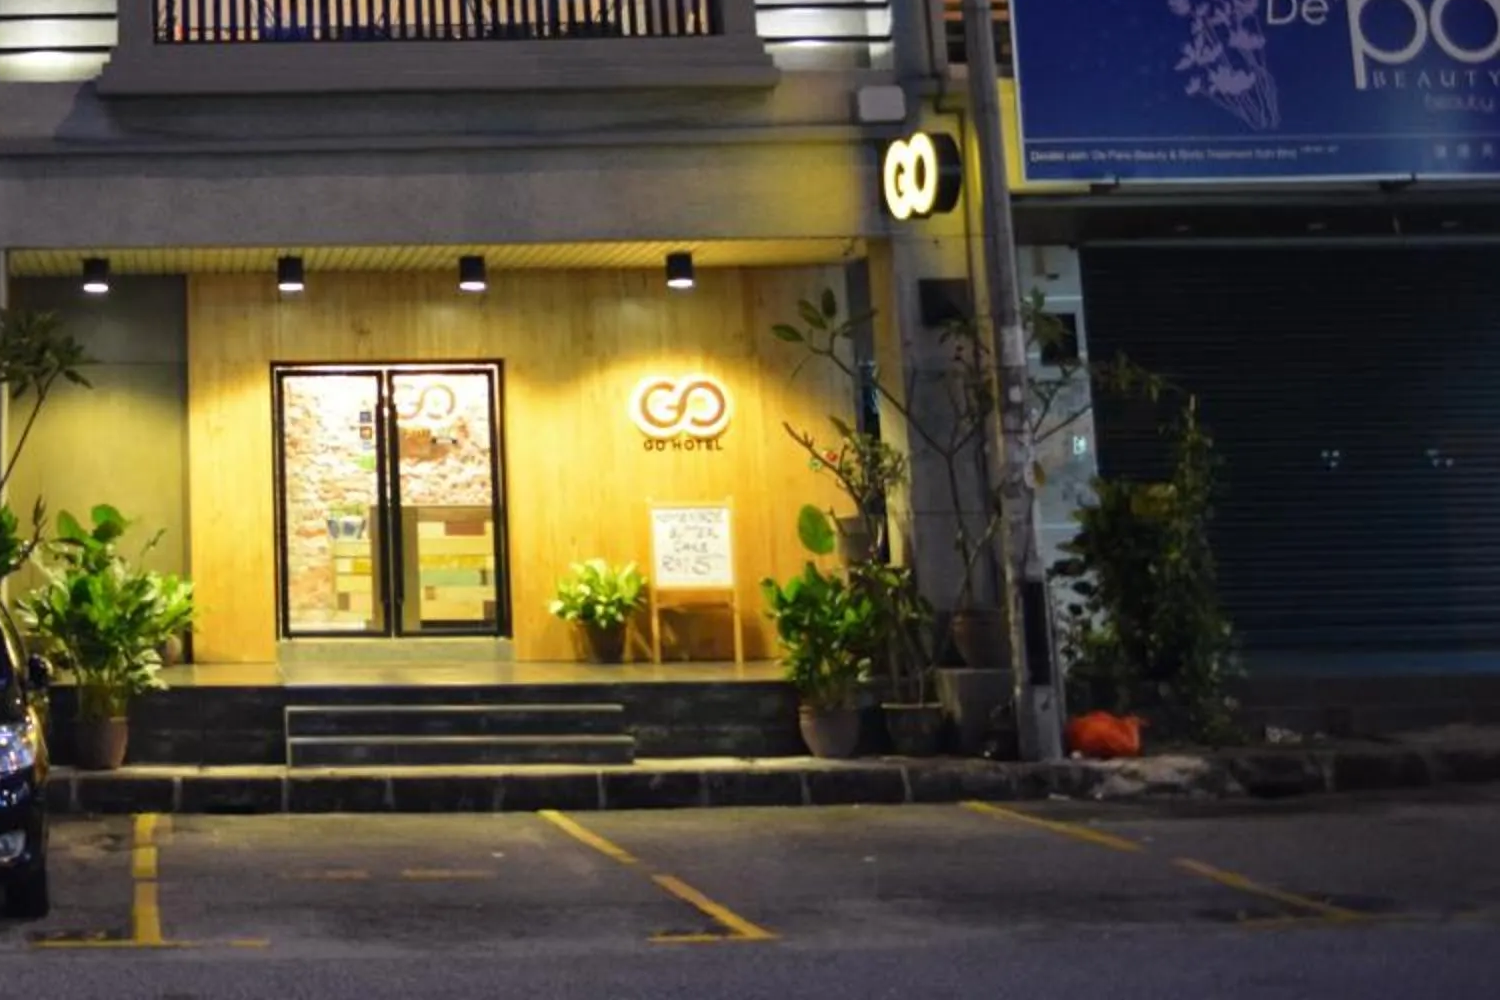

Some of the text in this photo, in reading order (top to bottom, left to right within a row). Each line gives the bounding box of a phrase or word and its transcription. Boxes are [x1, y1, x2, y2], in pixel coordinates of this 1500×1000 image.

[1372, 69, 1500, 89] BEAUTY
[884, 132, 938, 220] GO
[638, 380, 727, 429] GO
[643, 439, 724, 452] GO HOTEL
